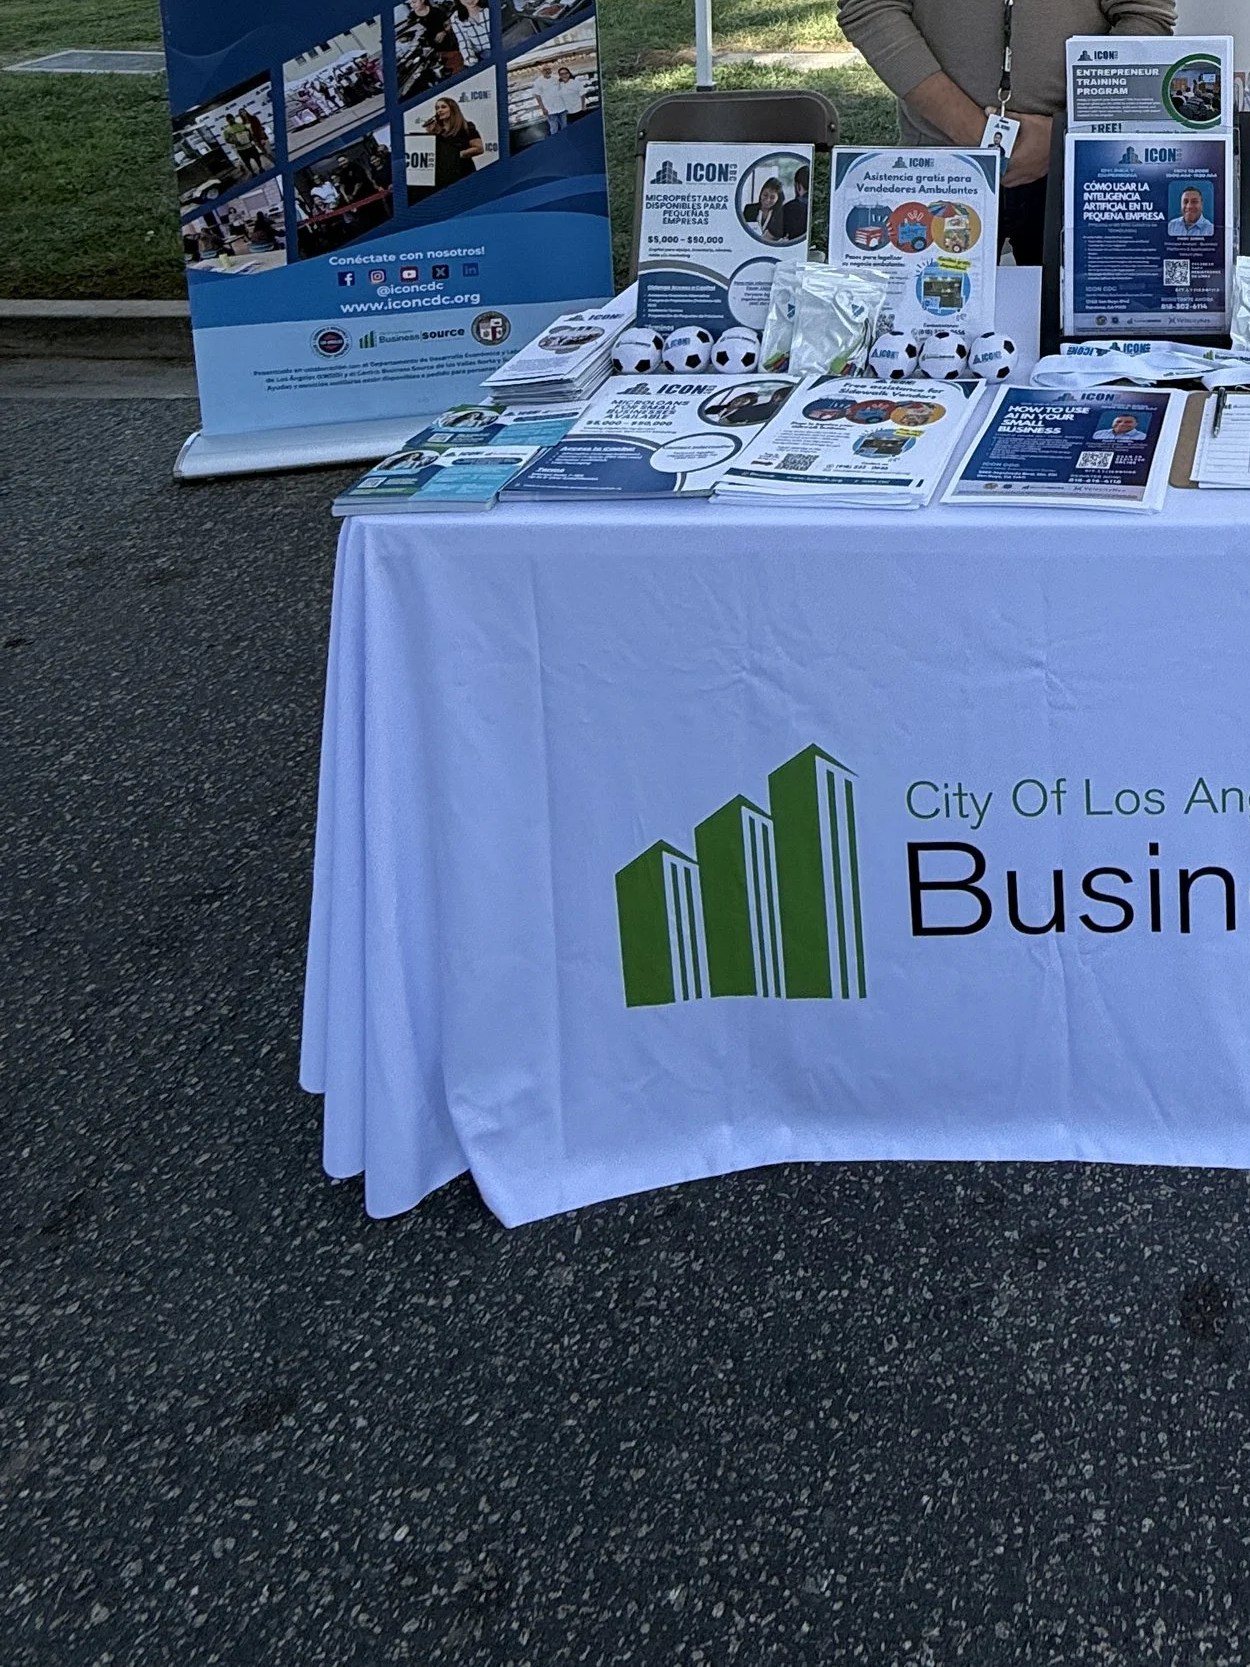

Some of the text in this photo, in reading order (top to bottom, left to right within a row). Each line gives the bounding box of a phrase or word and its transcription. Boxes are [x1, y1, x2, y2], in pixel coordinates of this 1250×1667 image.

[686, 163, 729, 182] ICON
[863, 172, 971, 184] Asistencia gratis para
[857, 183, 978, 194] Vendedores Ambulantes
[1083, 181, 1150, 191] CÓMO USAR LA
[646, 193, 728, 202] MICROPRÉSTAMOS
[1083, 192, 1141, 200] INTELIGENCIA
[1083, 202, 1153, 211] ARTIFICIAL EN TU
[663, 217, 708, 225] EMPRESAS
[329, 246, 485, 265] Conéctate con nosotros!
[377, 282, 444, 297] @iconcdc
[341, 293, 480, 313] www.iconcdc.org
[997, 426, 1061, 434] BUSINESS
[906, 780, 993, 830] City
[1011, 777, 1067, 818] Of
[1084, 778, 1166, 816] Los
